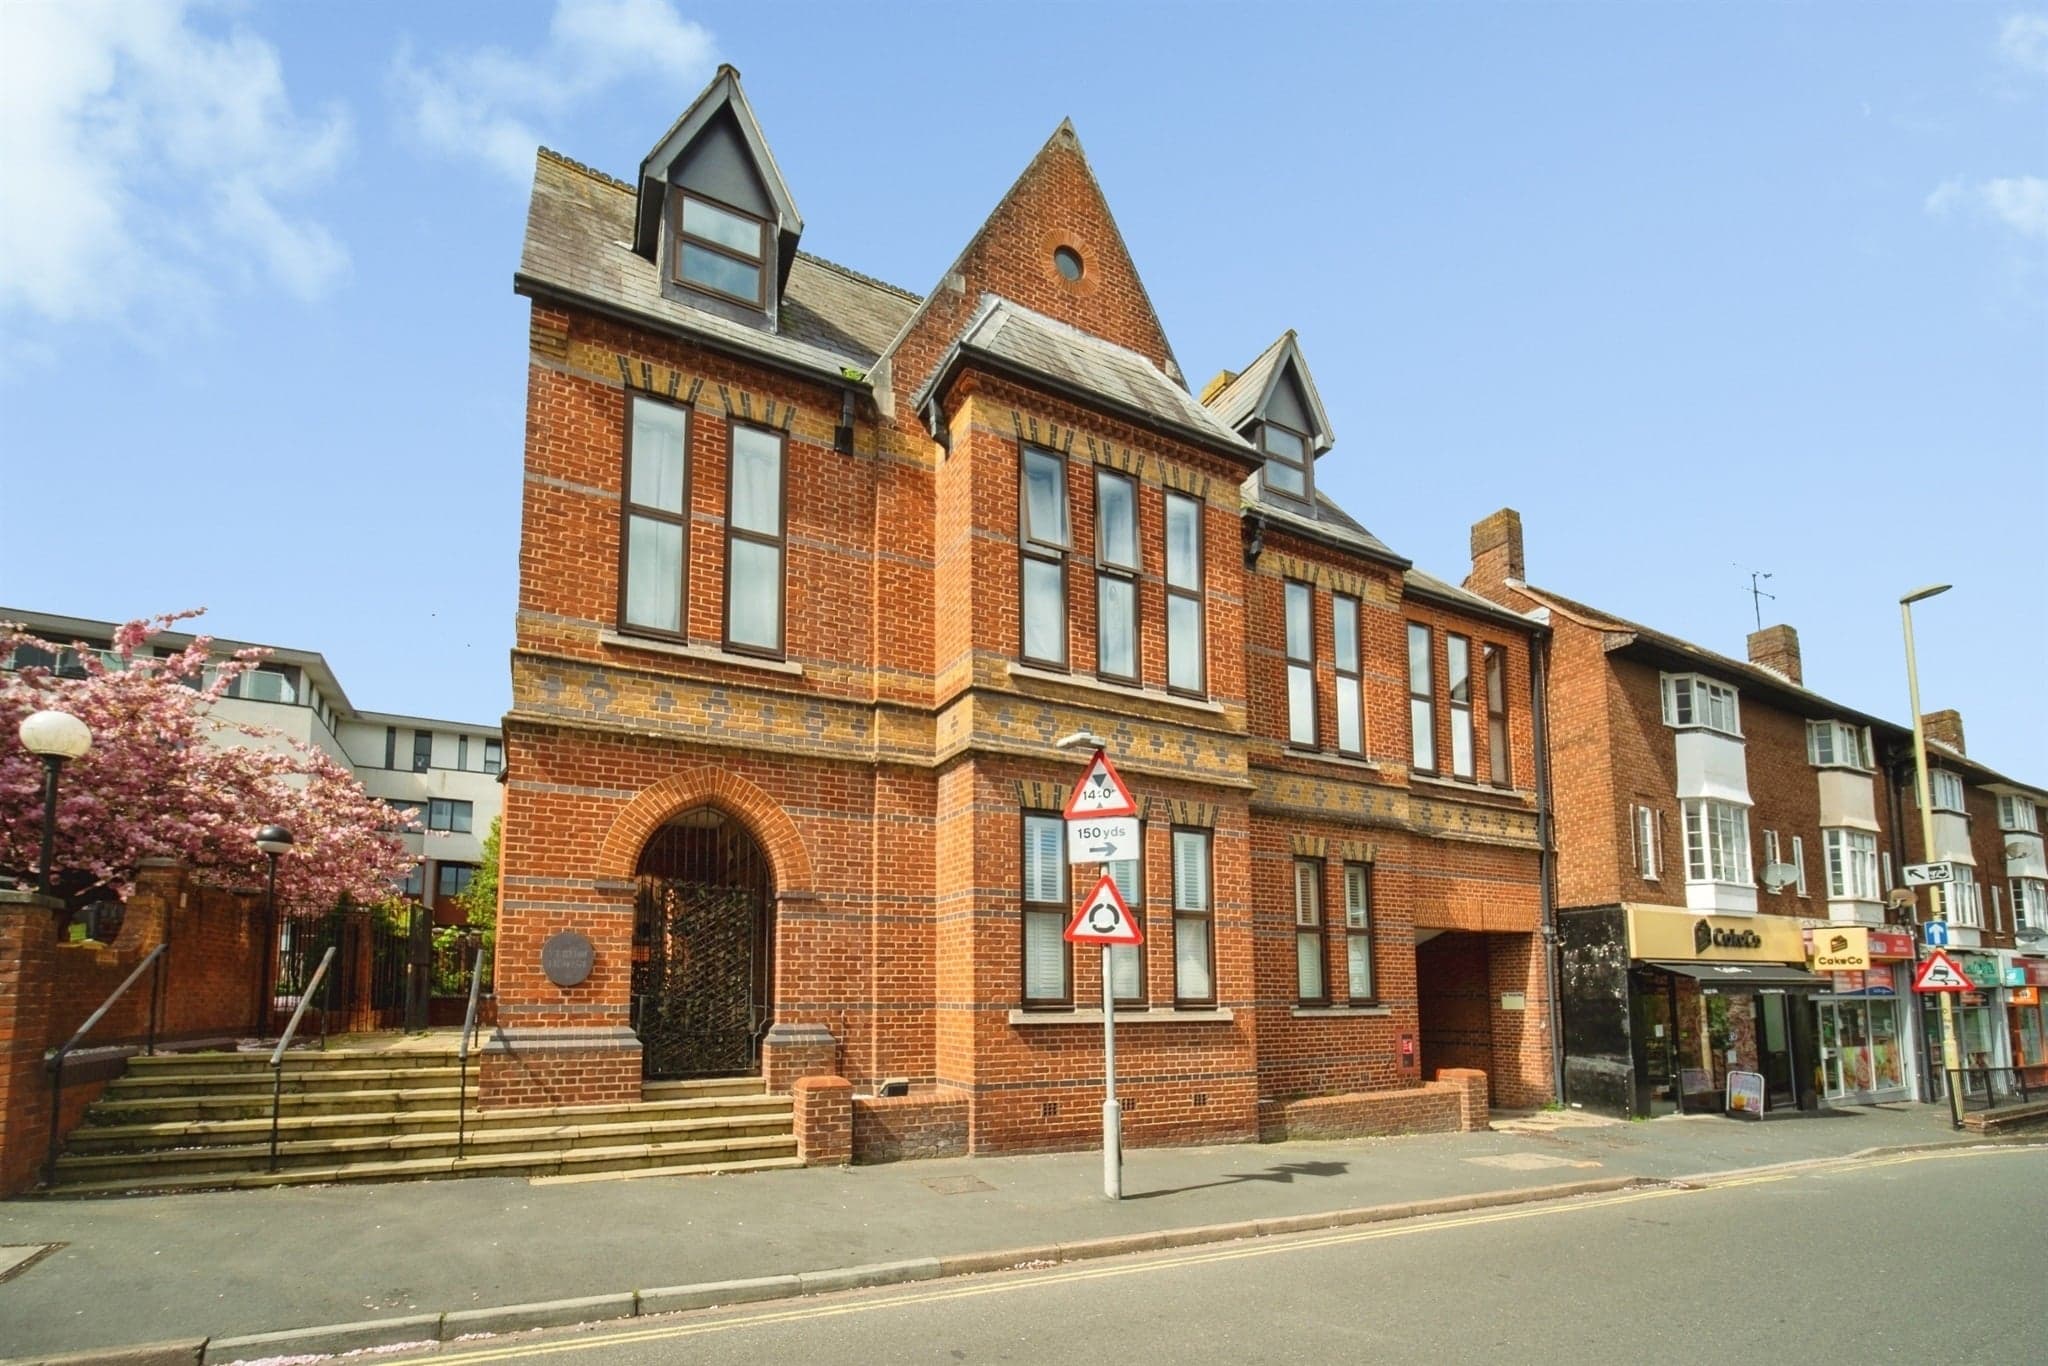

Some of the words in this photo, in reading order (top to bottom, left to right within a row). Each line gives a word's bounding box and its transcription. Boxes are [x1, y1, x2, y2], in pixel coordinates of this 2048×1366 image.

[1078, 827, 1101, 839] 150
[1103, 826, 1126, 839] yds
[1713, 928, 1761, 948] CakeCo
[1818, 956, 1863, 965] CakeCo
